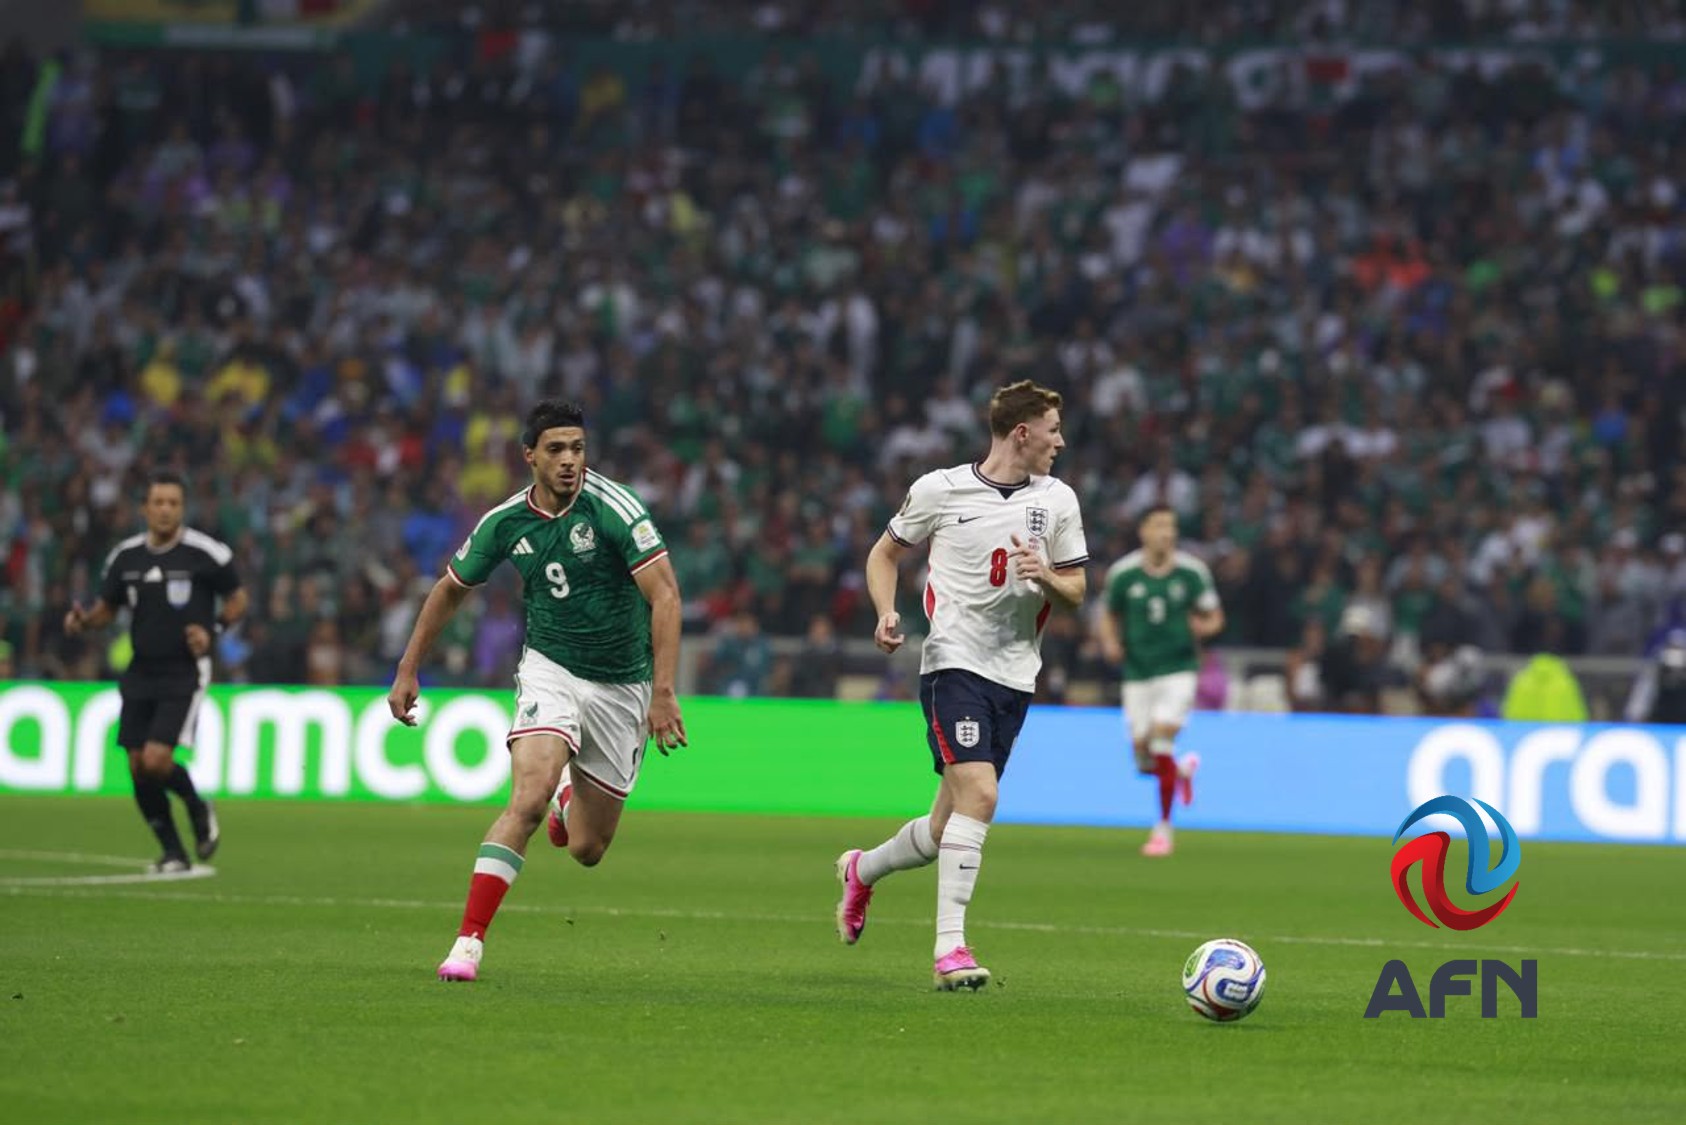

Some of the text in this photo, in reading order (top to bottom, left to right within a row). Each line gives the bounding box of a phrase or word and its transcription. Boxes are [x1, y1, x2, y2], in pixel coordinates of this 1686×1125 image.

[545, 562, 570, 599] 9
[989, 547, 1008, 588] 8
[1407, 724, 1686, 840] ara
